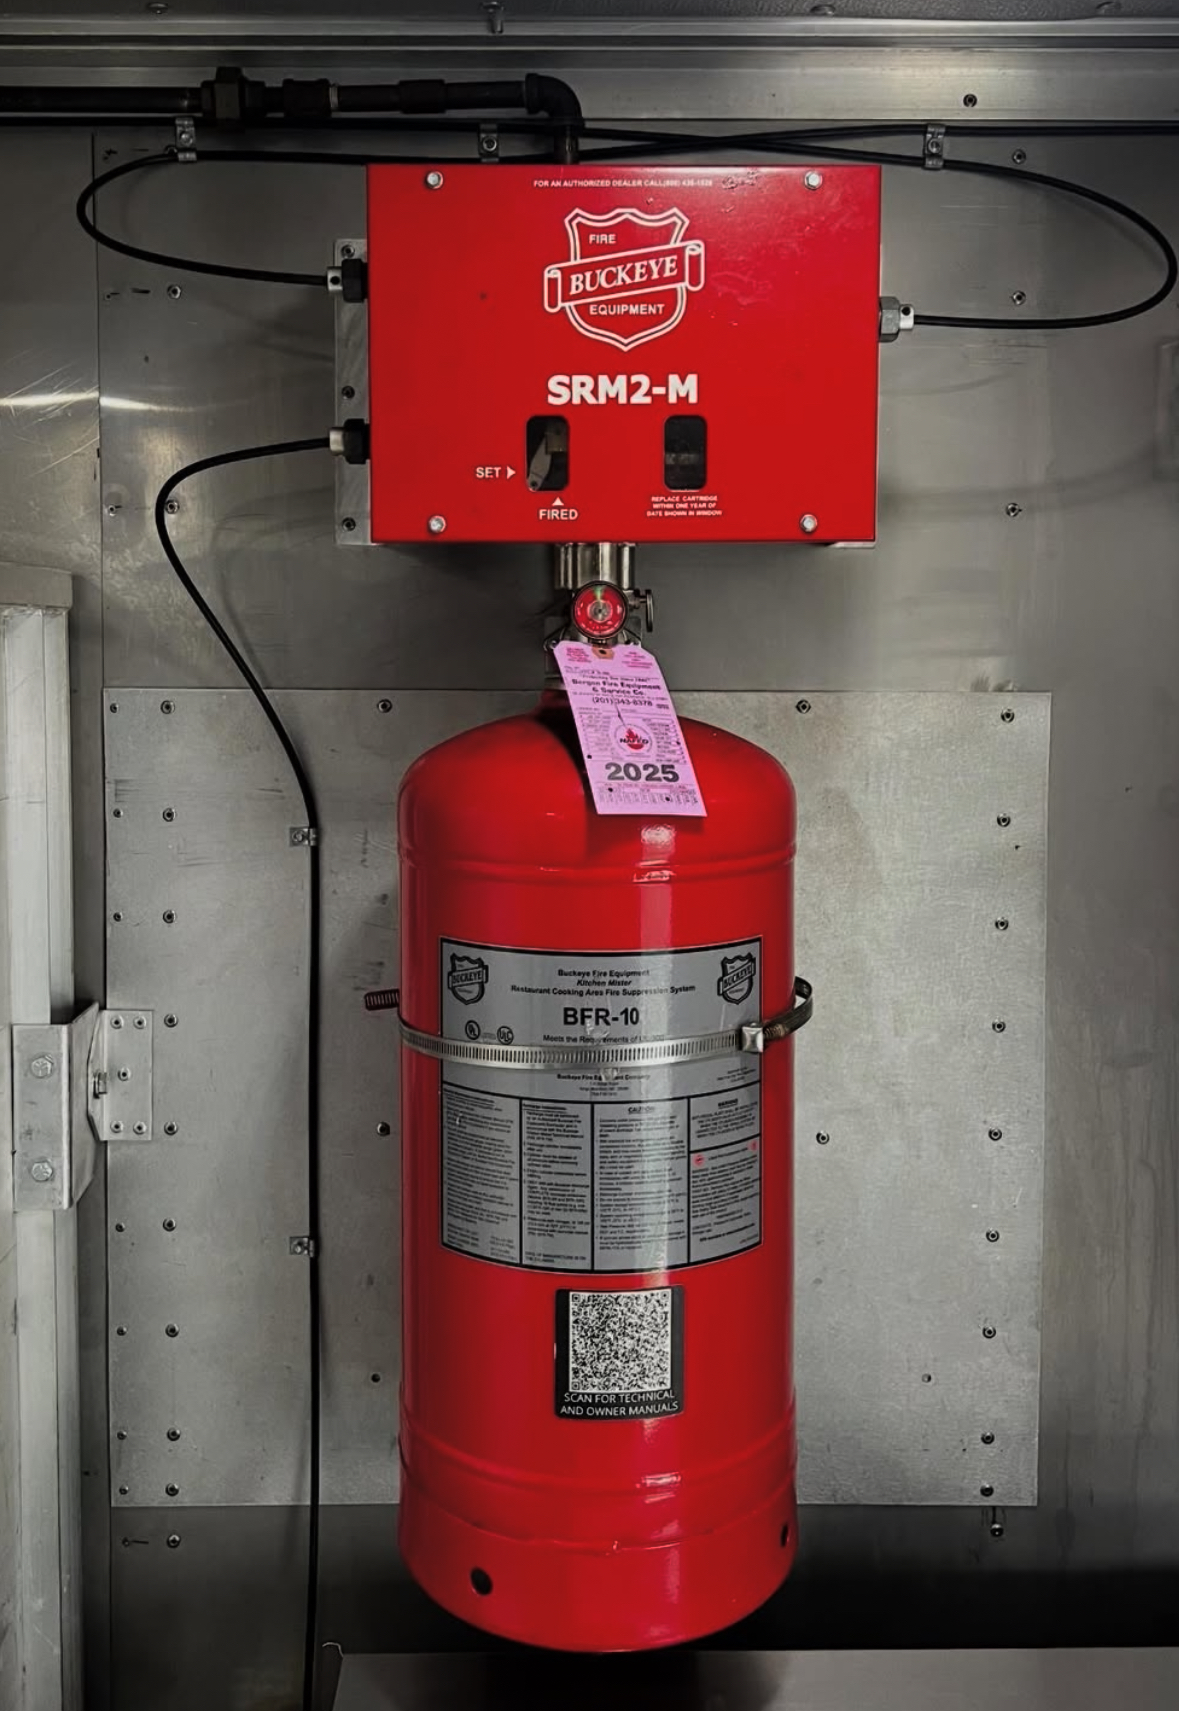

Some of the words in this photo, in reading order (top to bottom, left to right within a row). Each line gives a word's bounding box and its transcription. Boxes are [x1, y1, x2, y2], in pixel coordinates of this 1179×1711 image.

[534, 180, 549, 188] FOR
[551, 180, 562, 188] AN
[562, 180, 611, 188] AUTHORIZED
[612, 179, 643, 188] DEALER
[589, 234, 617, 244] FIRE
[569, 255, 678, 296] BUCKEYE
[589, 304, 665, 315] EQUIPMENT
[547, 374, 698, 405] SRM2-M
[476, 467, 501, 479] SET
[539, 509, 578, 520] FIRED
[602, 680, 619, 688] Fire
[605, 762, 679, 783] 2025
[558, 969, 591, 977] Buckeye
[592, 969, 607, 977] Fire
[609, 969, 650, 978] Equipment
[577, 979, 607, 987] Kitchen
[608, 979, 632, 987] Mister
[511, 985, 551, 995] Restaurant
[552, 988, 584, 997] Cooking
[585, 988, 603, 996] Area
[605, 988, 619, 996] Fire
[622, 986, 669, 996] Suppression
[670, 985, 696, 994] System
[563, 1007, 639, 1026] BFR-10
[543, 1034, 565, 1042] Meets
[566, 1035, 578, 1043] the
